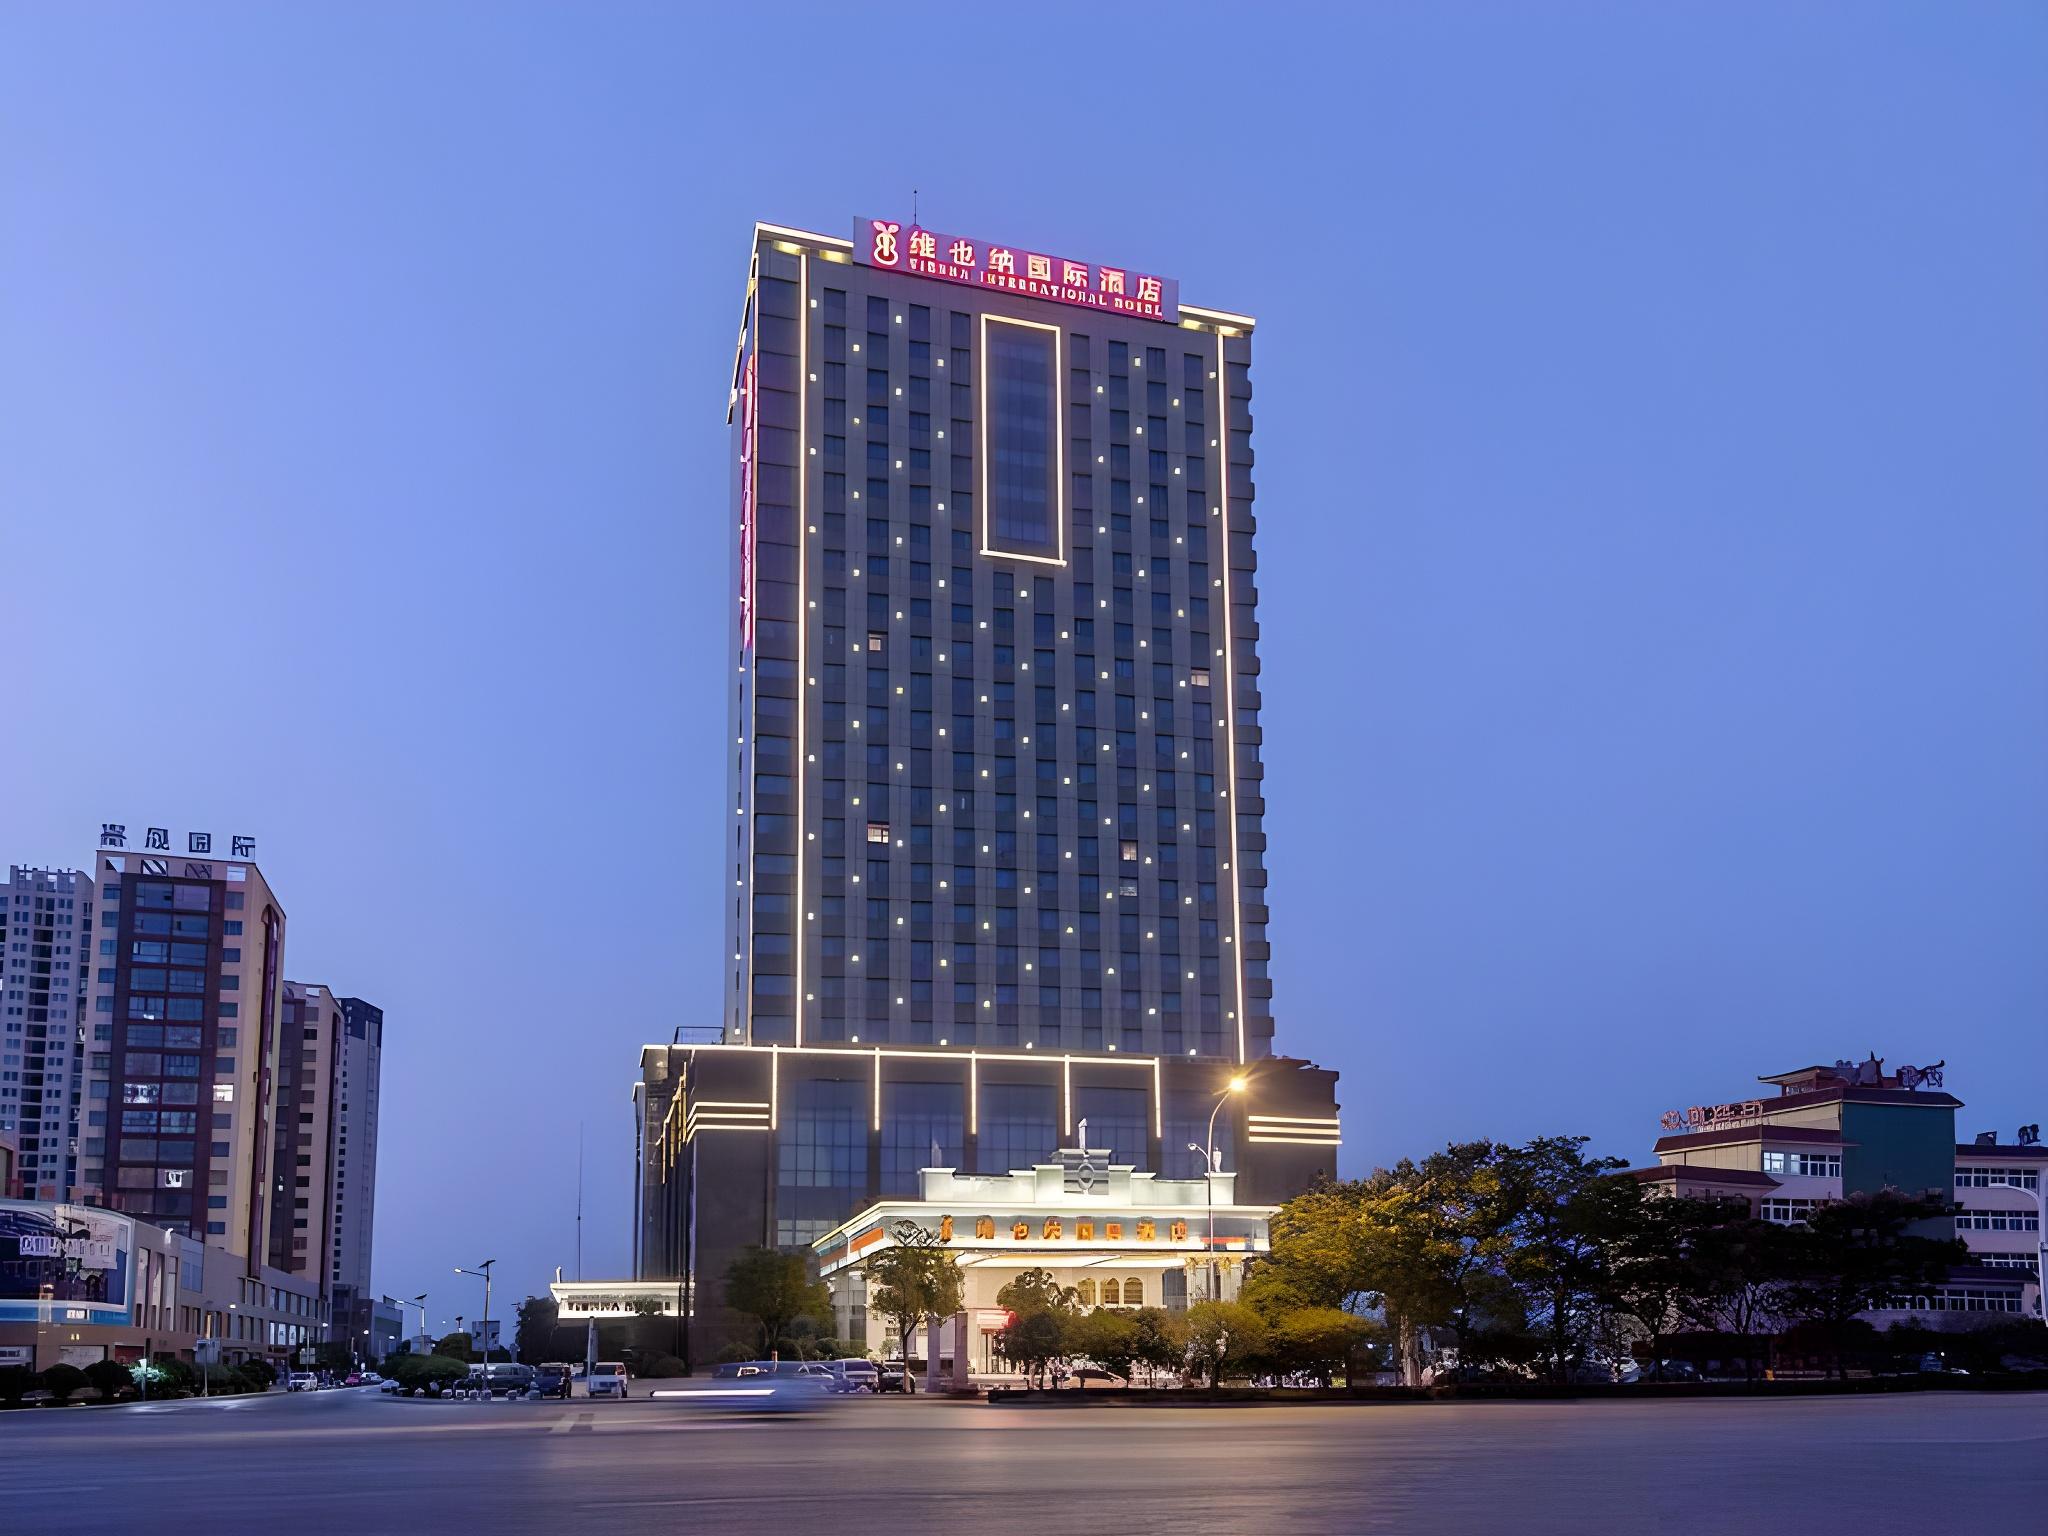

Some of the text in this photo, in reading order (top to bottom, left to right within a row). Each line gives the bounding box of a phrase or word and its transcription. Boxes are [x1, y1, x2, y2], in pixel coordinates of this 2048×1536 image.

[909, 230, 1162, 302] 维也纳国际酒店
